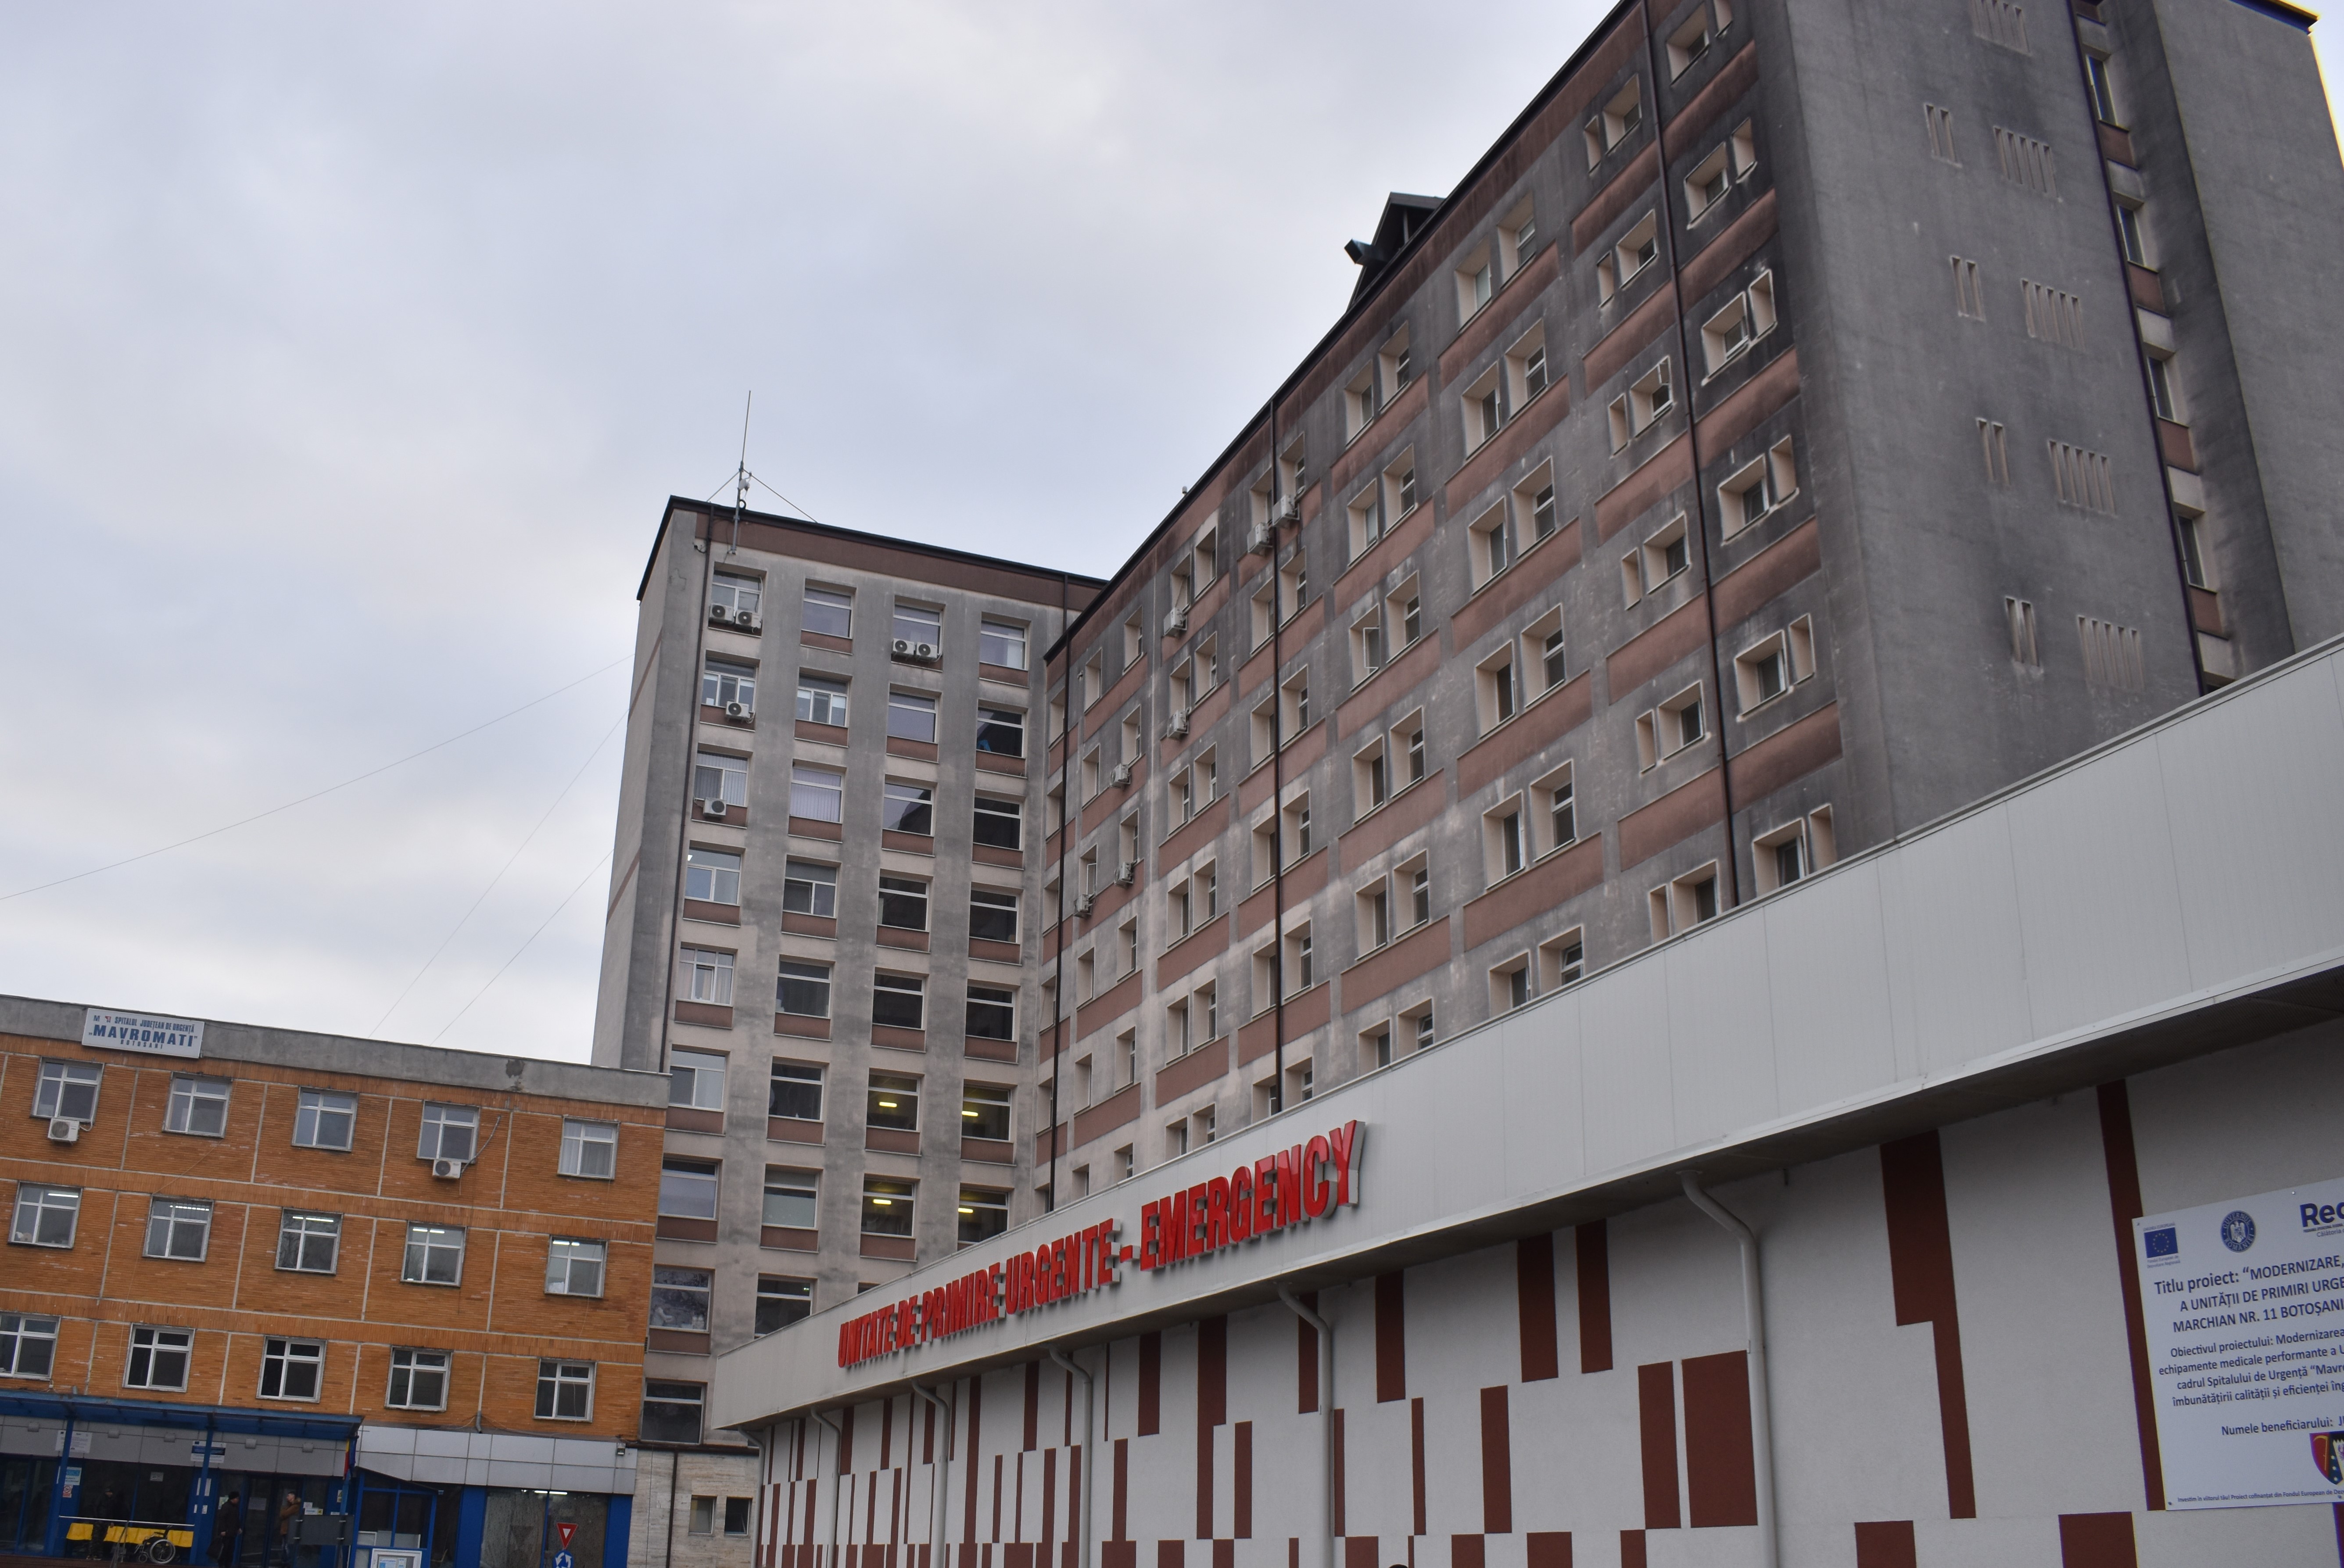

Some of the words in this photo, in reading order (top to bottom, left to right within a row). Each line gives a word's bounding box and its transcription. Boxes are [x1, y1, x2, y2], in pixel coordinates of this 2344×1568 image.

[115, 1017, 137, 1026] SPITALUL
[2223, 1213, 2251, 1228] GUVERNUL
[838, 1303, 896, 1368] UNITATE
[896, 1295, 920, 1350] DE
[921, 1262, 1003, 1342] PRIMIRE
[1005, 1218, 1117, 1314] URGENTE
[1140, 1120, 1361, 1271] EMERGENCY
[2224, 1234, 2254, 1250] ROMÂNIEI
[2317, 1228, 2341, 1237] Călătoria
[2154, 1278, 2184, 1294] Titlu
[2188, 1271, 2239, 1293] proiect:
[2180, 1300, 2188, 1312] A
[2191, 1292, 2239, 1310] UNITĂȚII
[2243, 1290, 2258, 1303] DE
[2262, 1282, 2308, 1300] PRIMIRI
[2173, 1314, 2236, 1332] MARCHIAN
[2239, 1311, 2260, 1323] NR.
[2263, 1308, 2277, 1321] 11
[2171, 1342, 2216, 1357] Obiectivul
[2219, 1336, 2273, 1353] proiectului:
[2159, 1361, 2217, 1375] echipamente
[2220, 1354, 2262, 1368] medicale
[2265, 1347, 2327, 1365] performante
[2177, 1377, 2205, 1389] cadrul
[2208, 1373, 2251, 1388] Spitalului
[2254, 1372, 2266, 1381] de
[2269, 1366, 2308, 1381] Urgență
[2172, 1391, 2232, 1407] îmbunătățirii
[2235, 1387, 2270, 1400] calității
[2272, 1387, 2280, 1399] și
[2283, 1381, 2330, 1396] eficienței
[2222, 1423, 2259, 1436] Numele
[2261, 1417, 2333, 1433] beneficiarului:
